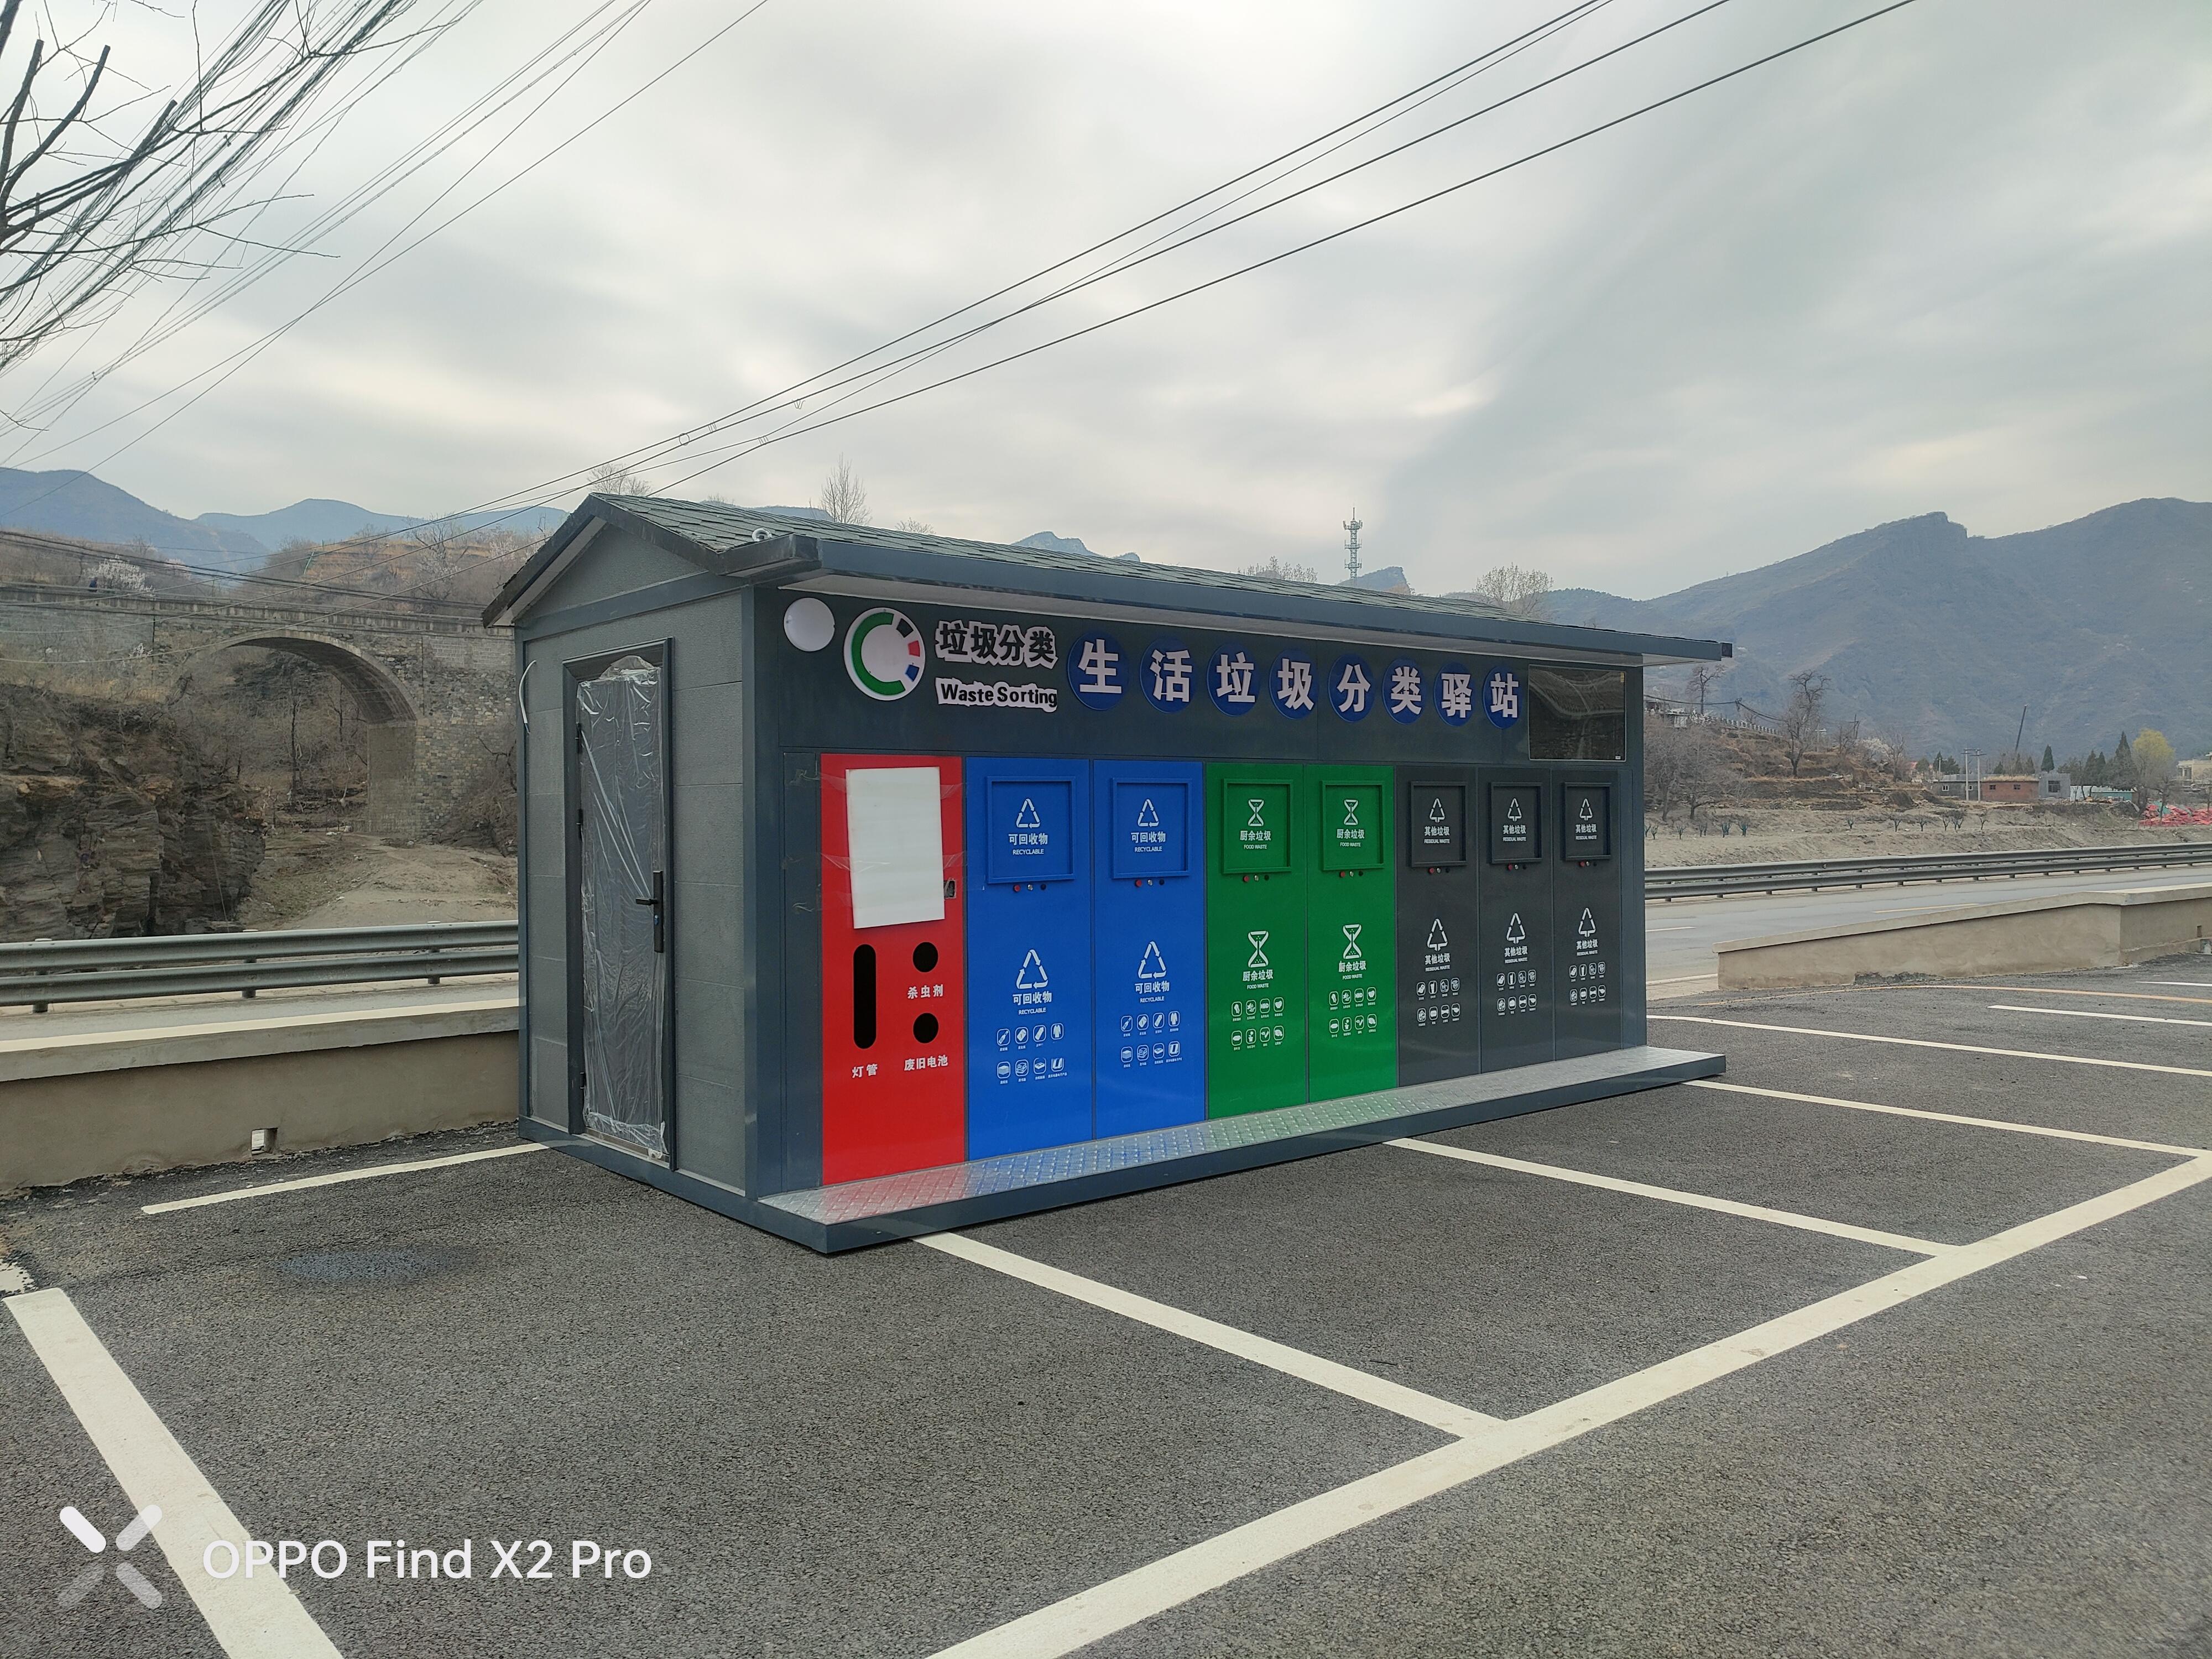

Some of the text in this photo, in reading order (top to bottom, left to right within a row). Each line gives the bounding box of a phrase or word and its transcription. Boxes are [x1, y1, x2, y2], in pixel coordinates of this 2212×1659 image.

[940, 622, 1054, 664] 垃圾分类
[1078, 639, 1519, 719] 生活垃圾分类驿站
[941, 683, 1057, 707] Waste Sorting
[1337, 829, 1365, 839] 厨余垃圾
[1424, 826, 1450, 836] 其他垃圾
[1503, 825, 1526, 834] 其他垃圾
[1575, 823, 1597, 833] 其他垃圾
[1008, 833, 1048, 846] 可回收物
[1130, 831, 1166, 843] 可回收物
[1240, 830, 1271, 841] 厨余垃圾
[1576, 939, 1598, 950] 其他垃圾
[1504, 946, 1528, 957] 其他垃圾
[1425, 953, 1451, 965] 其他垃圾
[1338, 960, 1366, 972] 厨余垃圾
[1242, 969, 1274, 982] 厨余垃圾
[907, 984, 944, 999] 杀虫剂
[1134, 980, 1170, 994] 可回收物
[1012, 990, 1052, 1006] 可回收物
[1018, 1007, 1047, 1015] RECYCLABLE
[904, 1054, 949, 1071] 废旧电池
[852, 1063, 878, 1078] 灯管
